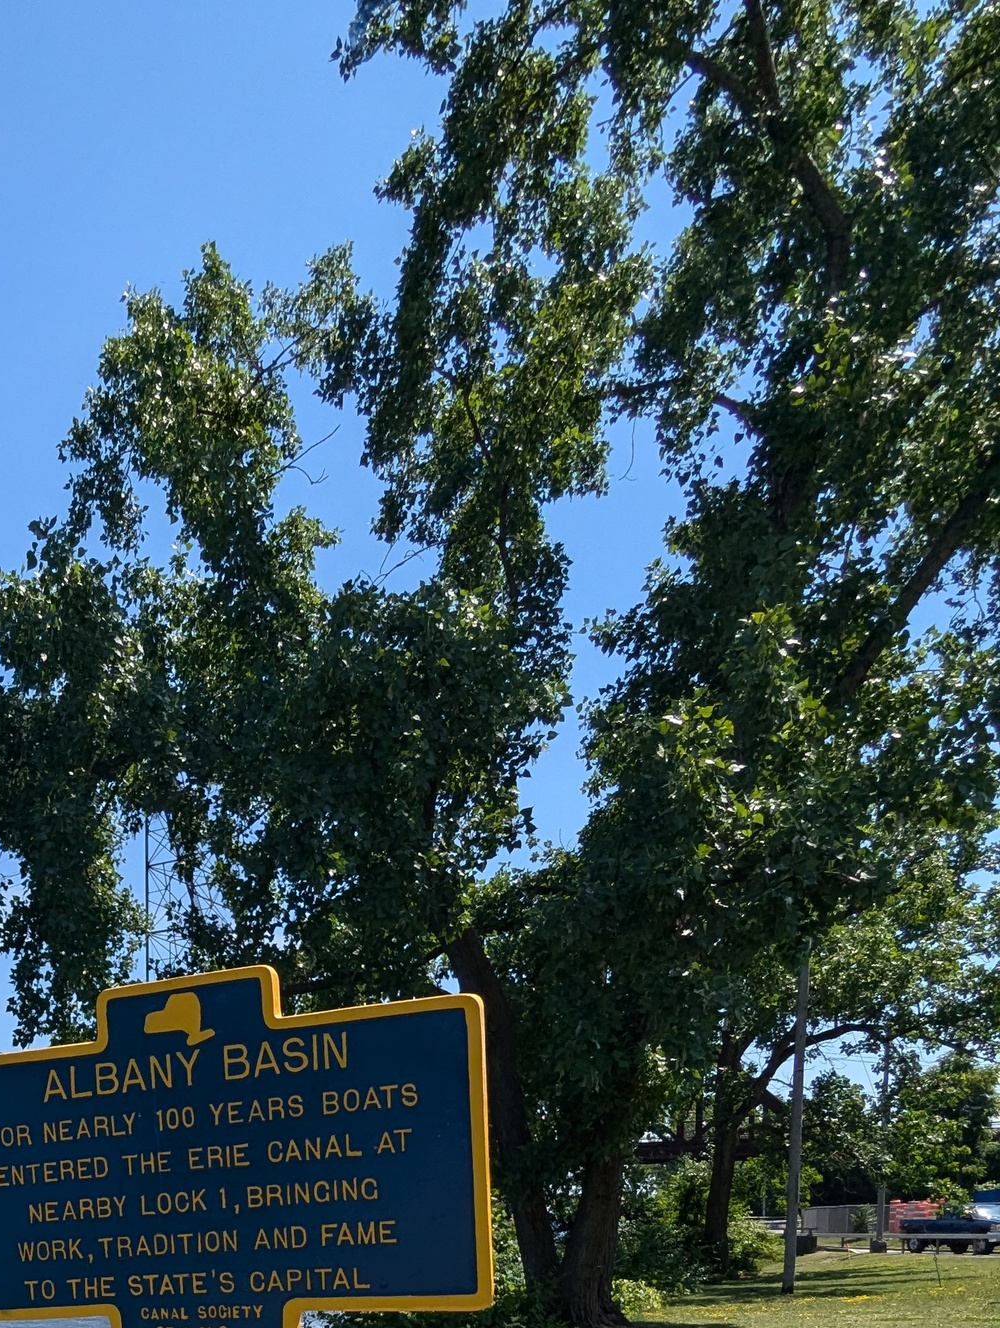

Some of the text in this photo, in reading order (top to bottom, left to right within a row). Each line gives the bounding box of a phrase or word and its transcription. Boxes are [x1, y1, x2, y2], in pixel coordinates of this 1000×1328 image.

[43, 1029, 348, 1103] ALBANY BASIN
[42, 1113, 135, 1143] NEARLY
[156, 1106, 195, 1131] 100
[210, 1094, 305, 1125] YEARS
[321, 1083, 419, 1116] BOATS
[122, 1151, 170, 1174] THE
[188, 1143, 249, 1170] ERIE
[267, 1135, 363, 1164] CANAL
[377, 1128, 411, 1153] AT
[28, 1197, 125, 1223] NEARBY
[140, 1190, 207, 1216] LOCK
[254, 1225, 308, 1249] AND
[320, 1220, 397, 1247] FAME
[24, 1267, 371, 1300] TO THE STATE'S CAPITAL
[140, 1305, 263, 1322] CANAL SOCIETY
